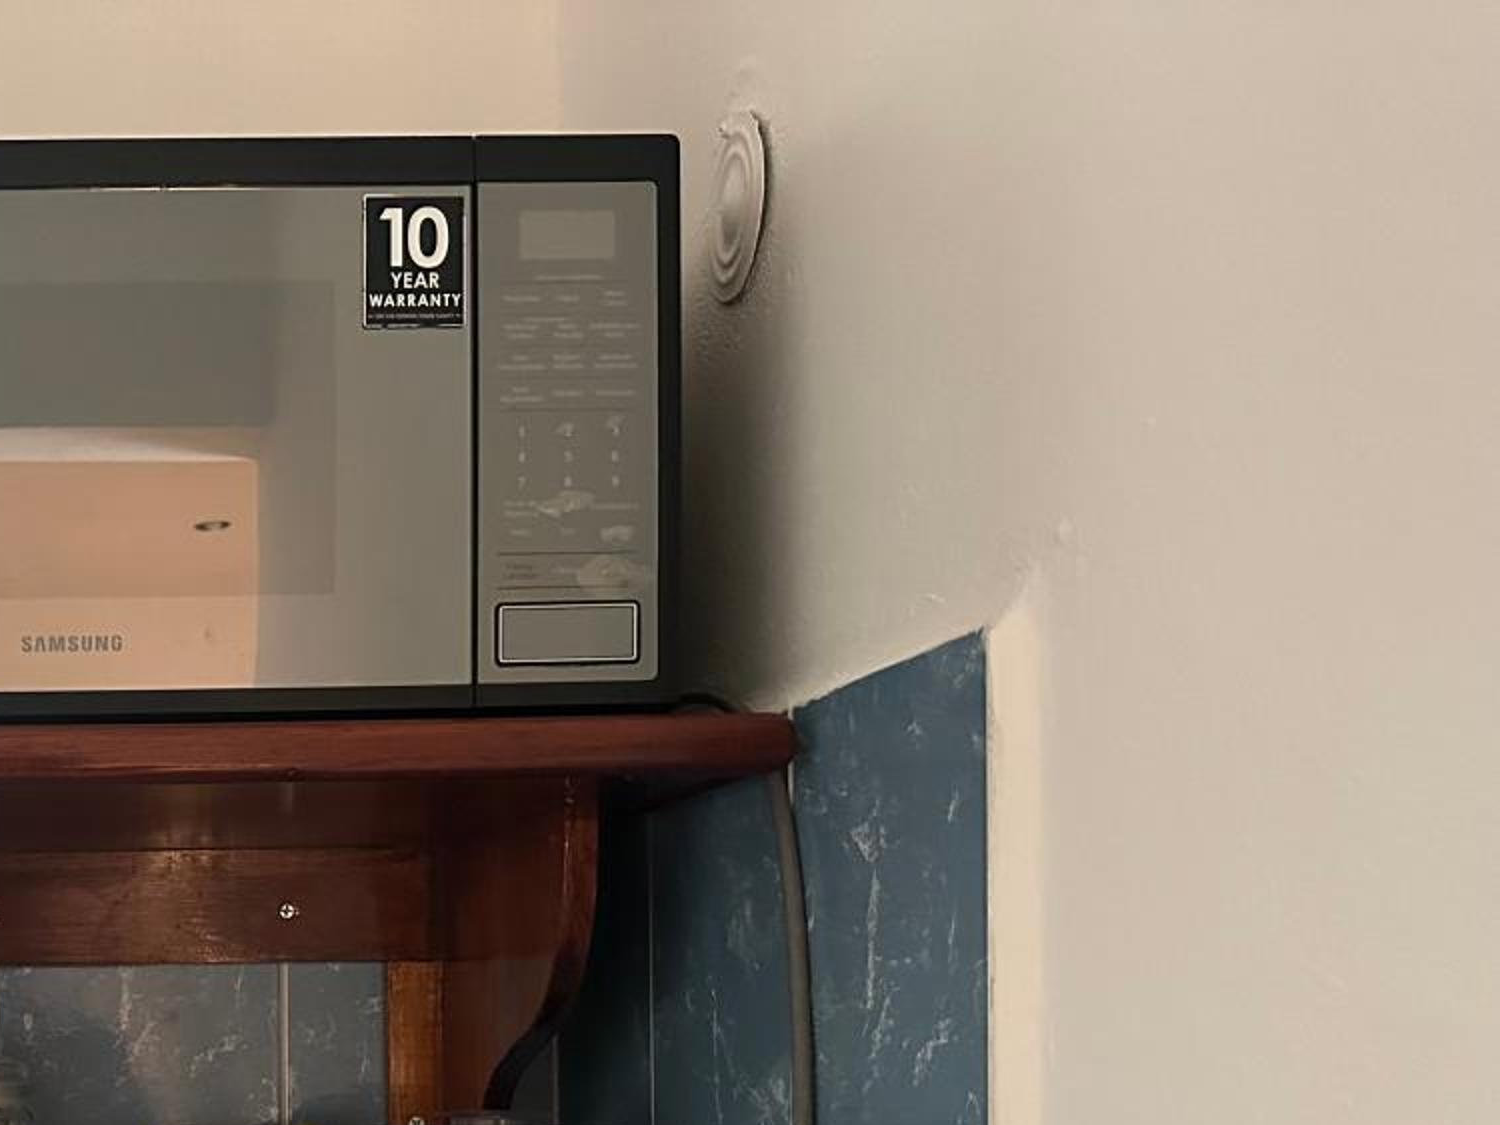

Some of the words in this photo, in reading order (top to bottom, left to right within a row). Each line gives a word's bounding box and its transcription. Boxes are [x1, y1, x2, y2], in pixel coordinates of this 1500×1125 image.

[379, 205, 450, 269] 10
[390, 271, 440, 289] YEAR
[368, 293, 462, 308] WARRANTY
[20, 634, 123, 653] SAMSUNG
